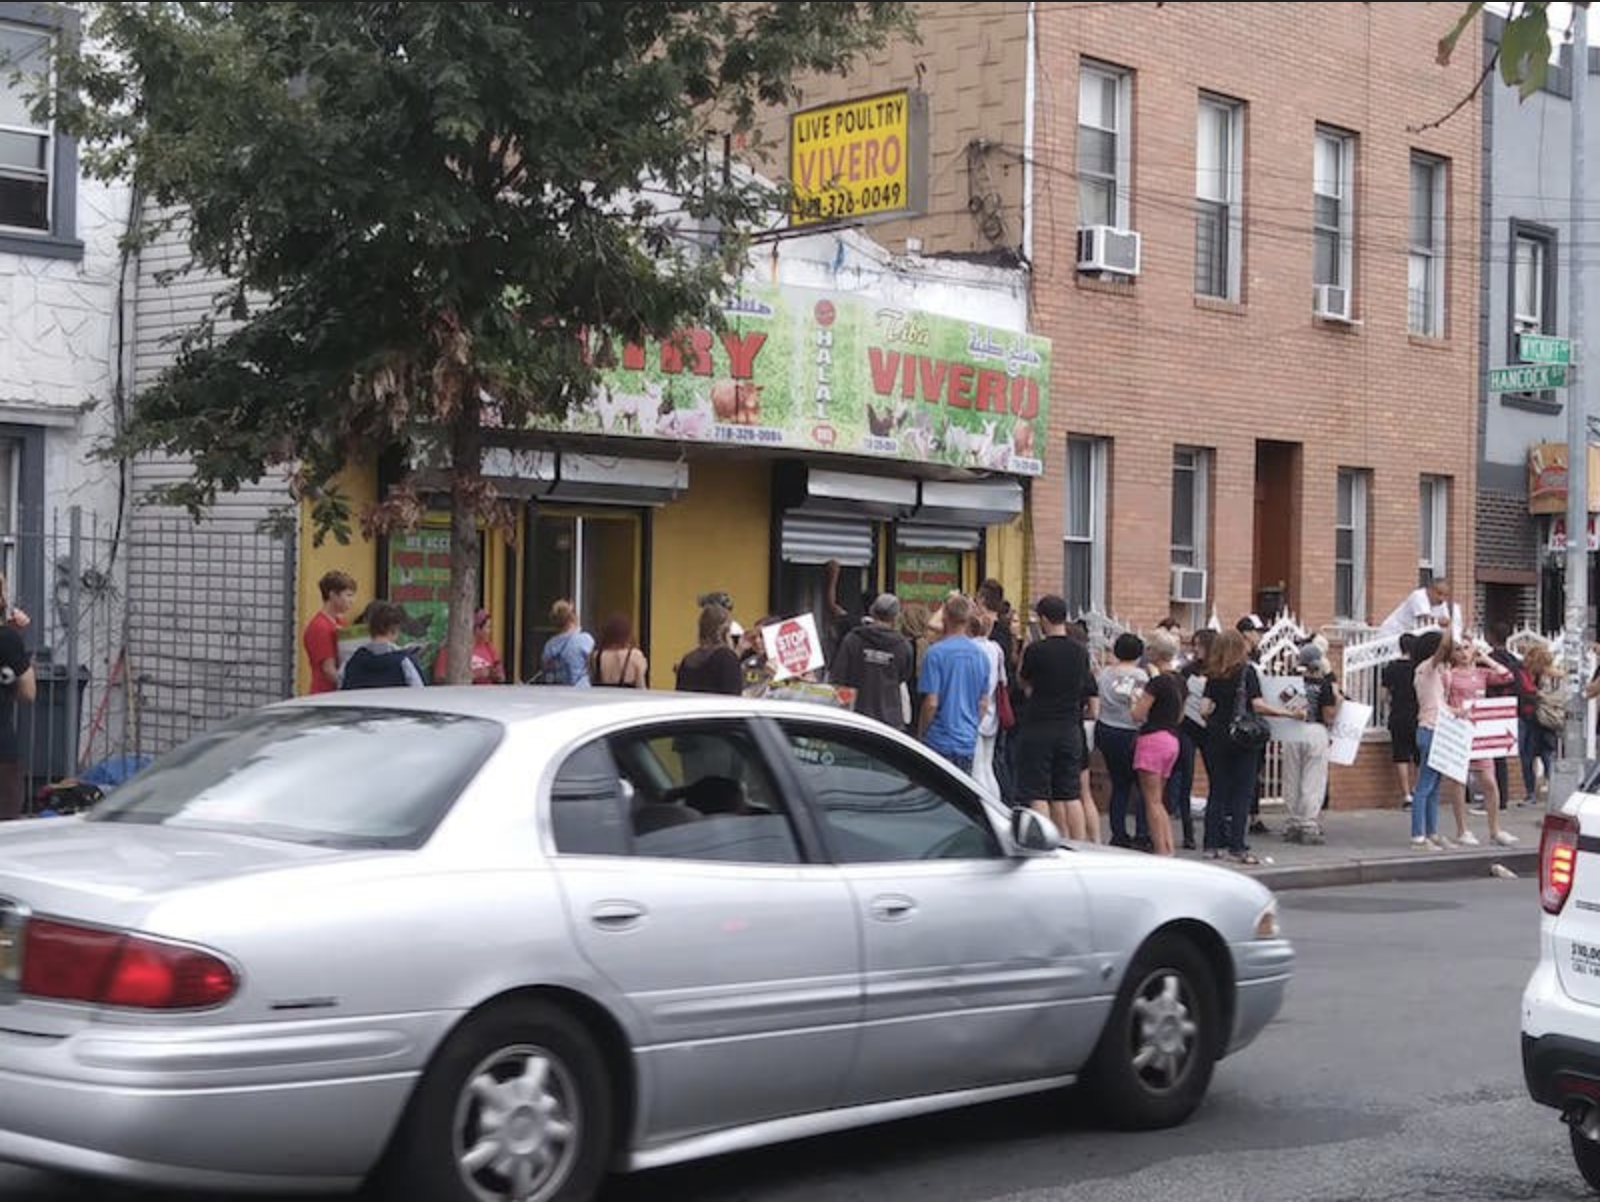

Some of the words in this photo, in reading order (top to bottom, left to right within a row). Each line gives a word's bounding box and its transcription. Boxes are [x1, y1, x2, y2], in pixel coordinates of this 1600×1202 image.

[798, 115, 830, 143] LIVE
[836, 100, 904, 136] POULTRY
[799, 134, 901, 194] VIVERO
[815, 328, 833, 419] HALAL
[867, 345, 1040, 421] VIVERO
[1490, 368, 1549, 389] HANCOCK
[778, 629, 807, 651] STOP
